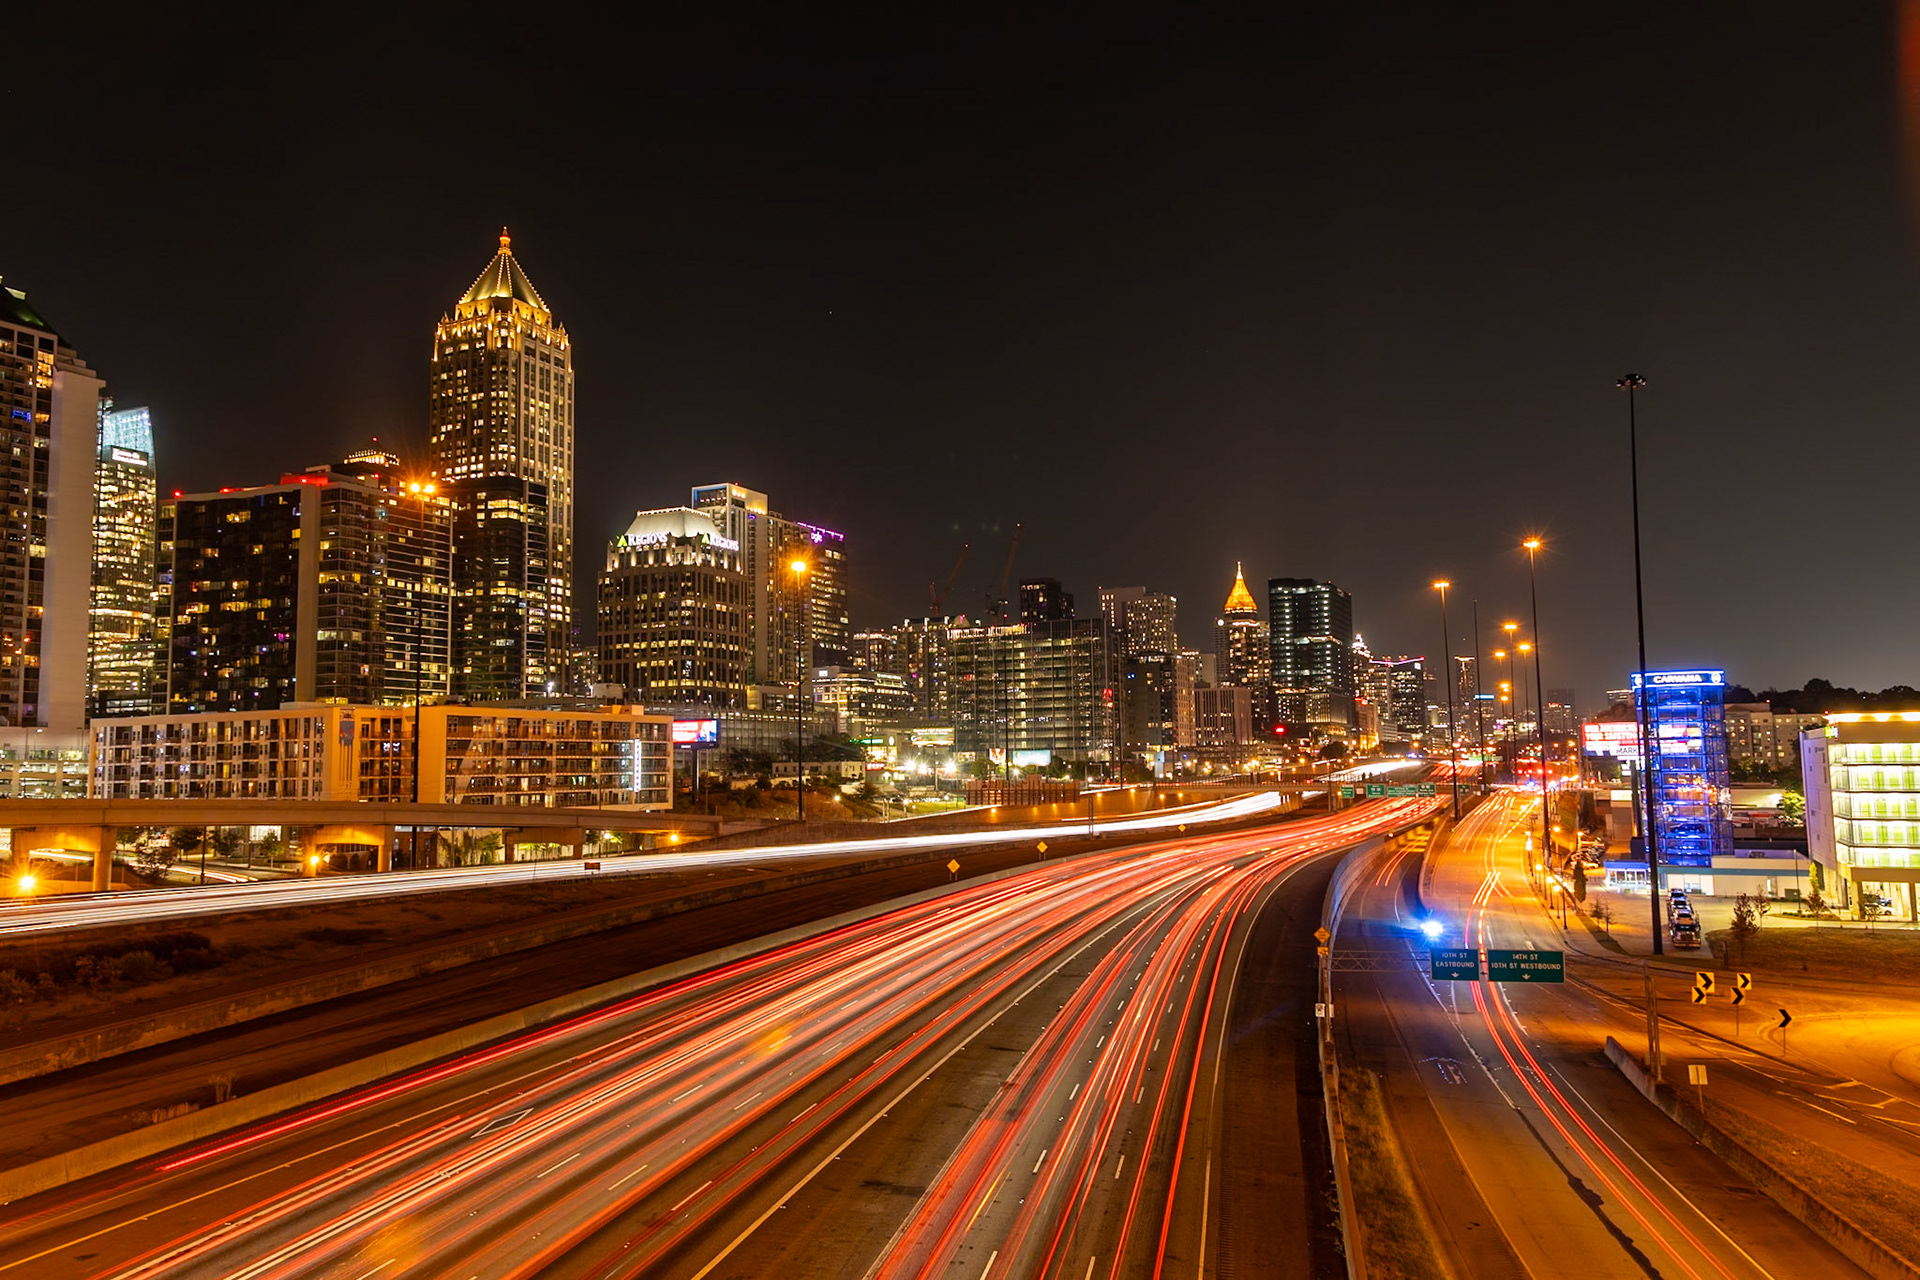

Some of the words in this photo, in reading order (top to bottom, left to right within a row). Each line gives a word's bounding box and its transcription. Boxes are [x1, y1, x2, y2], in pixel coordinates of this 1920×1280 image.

[628, 532, 668, 546] REGIONS
[1653, 674, 1702, 684] CARVANA
[1435, 960, 1475, 968] EASTBOUND
[1520, 962, 1561, 970] WESTBOUND
